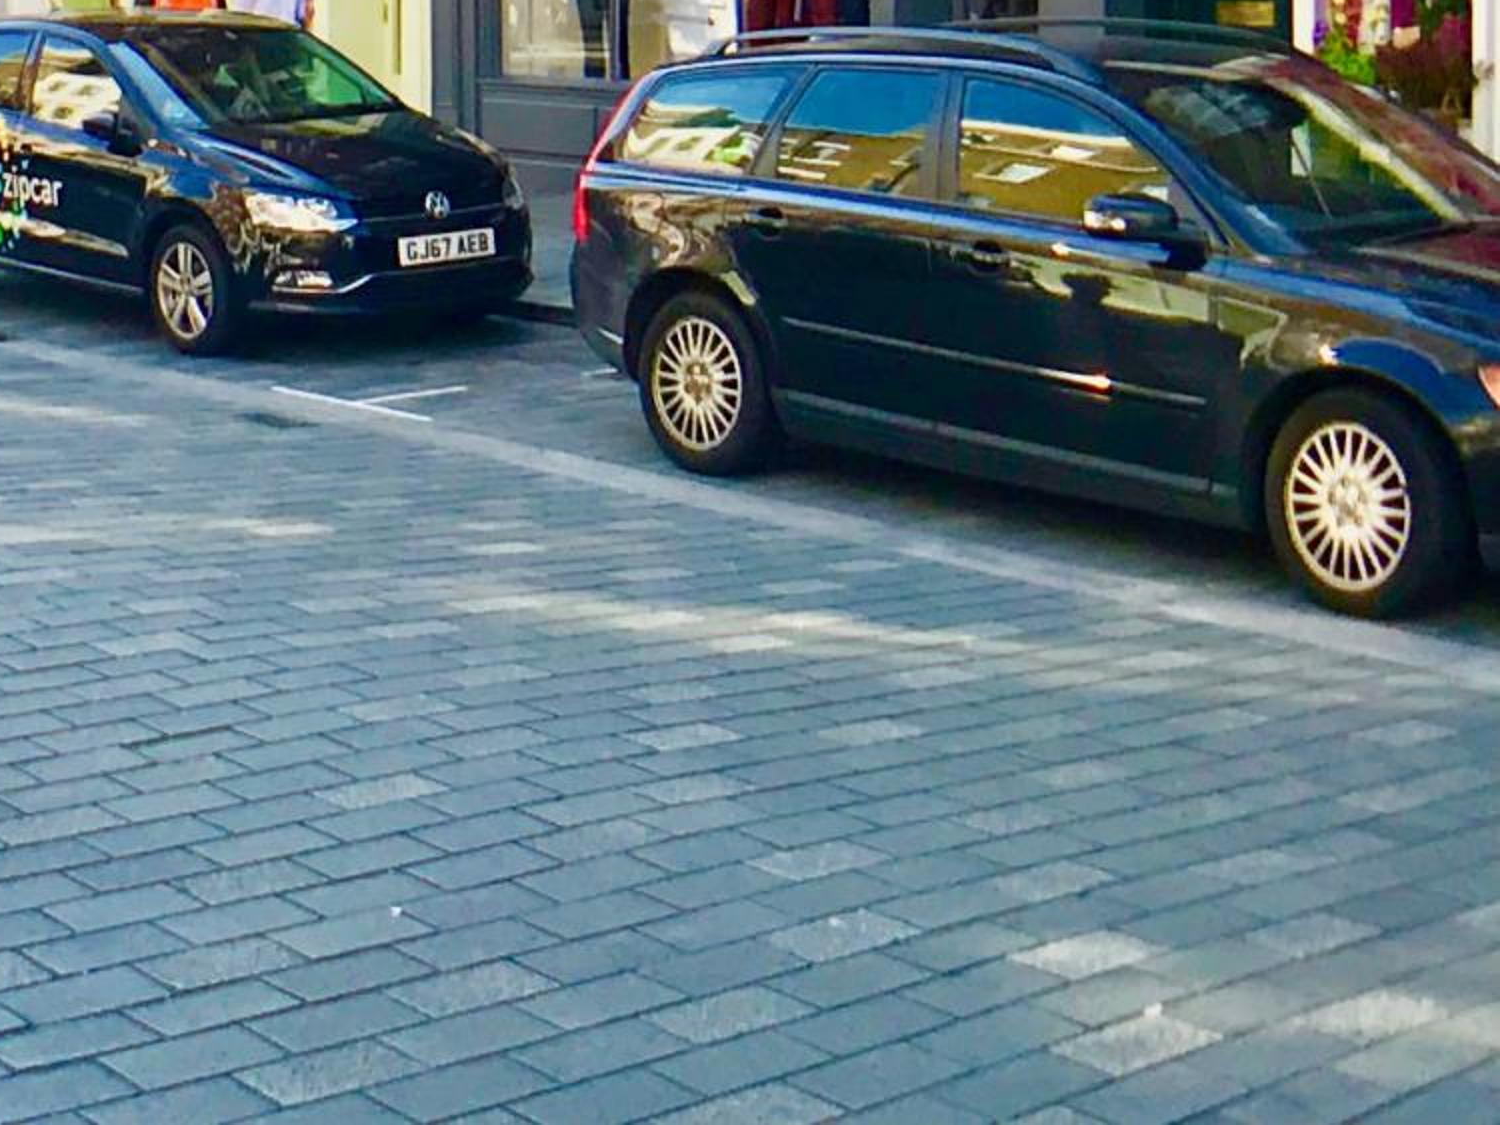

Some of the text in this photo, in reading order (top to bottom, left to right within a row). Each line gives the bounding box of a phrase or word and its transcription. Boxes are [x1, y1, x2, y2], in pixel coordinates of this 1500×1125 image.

[2, 165, 63, 210] zipcar
[405, 232, 490, 262] GJ67 AEB
